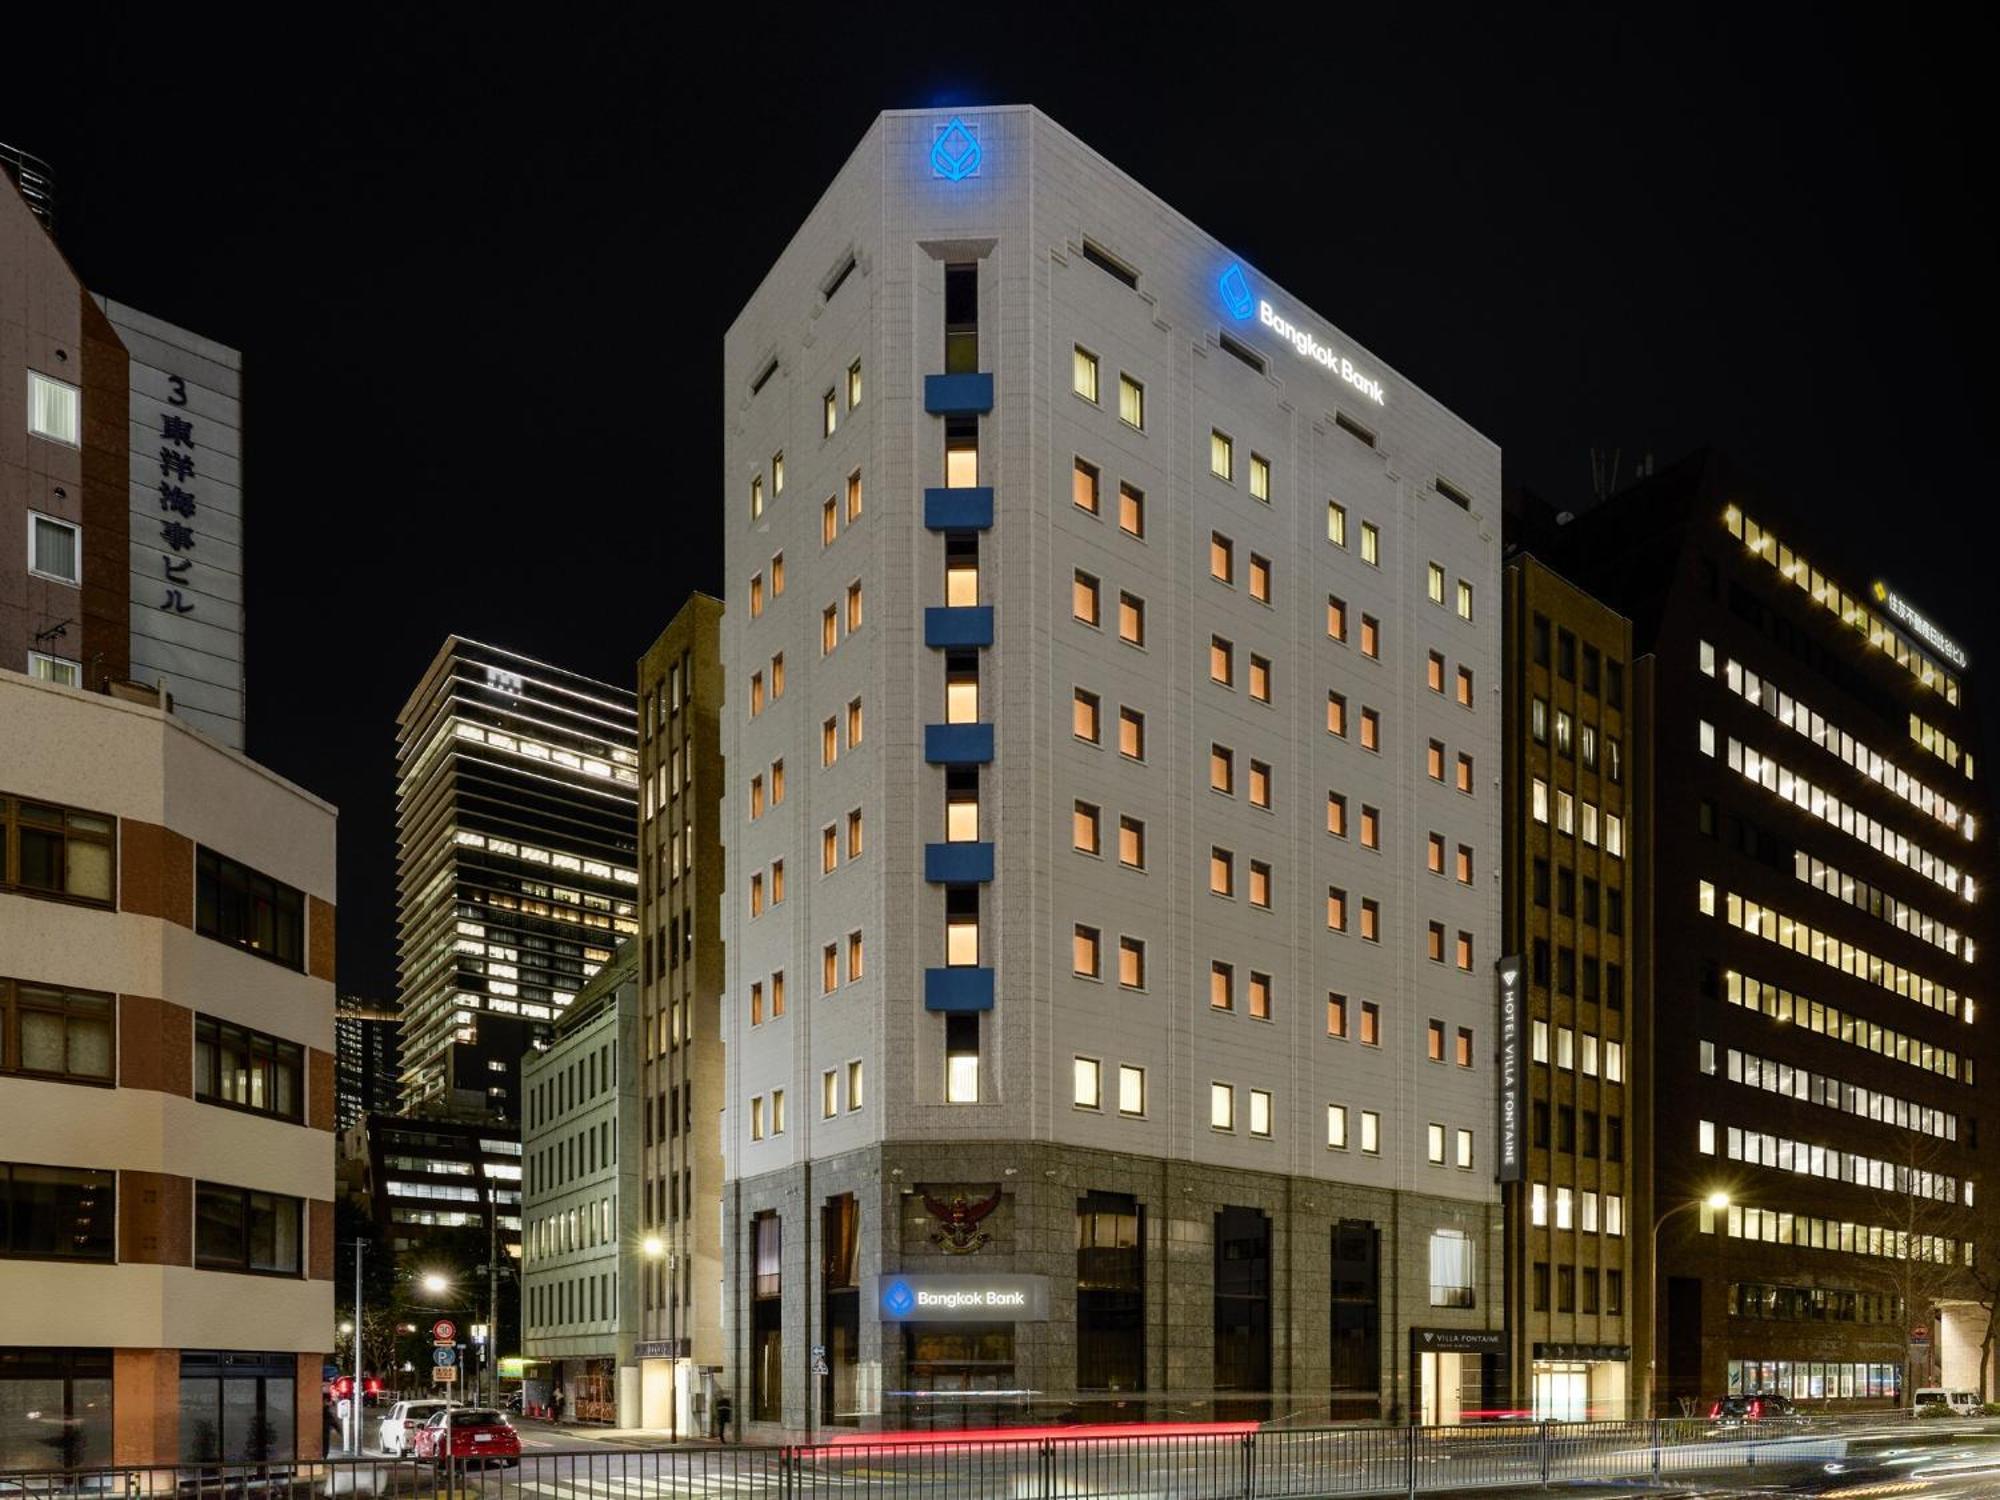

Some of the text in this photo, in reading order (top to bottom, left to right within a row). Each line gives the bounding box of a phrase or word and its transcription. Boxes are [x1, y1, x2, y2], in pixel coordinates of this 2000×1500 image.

[1260, 299, 1385, 406] Bangkok Bank
[1504, 991, 1515, 1166] HOTEL VILLA FONTAINE
[918, 1291, 1025, 1308] Bangkok Bank
[1436, 1334, 1459, 1342] VILLA
